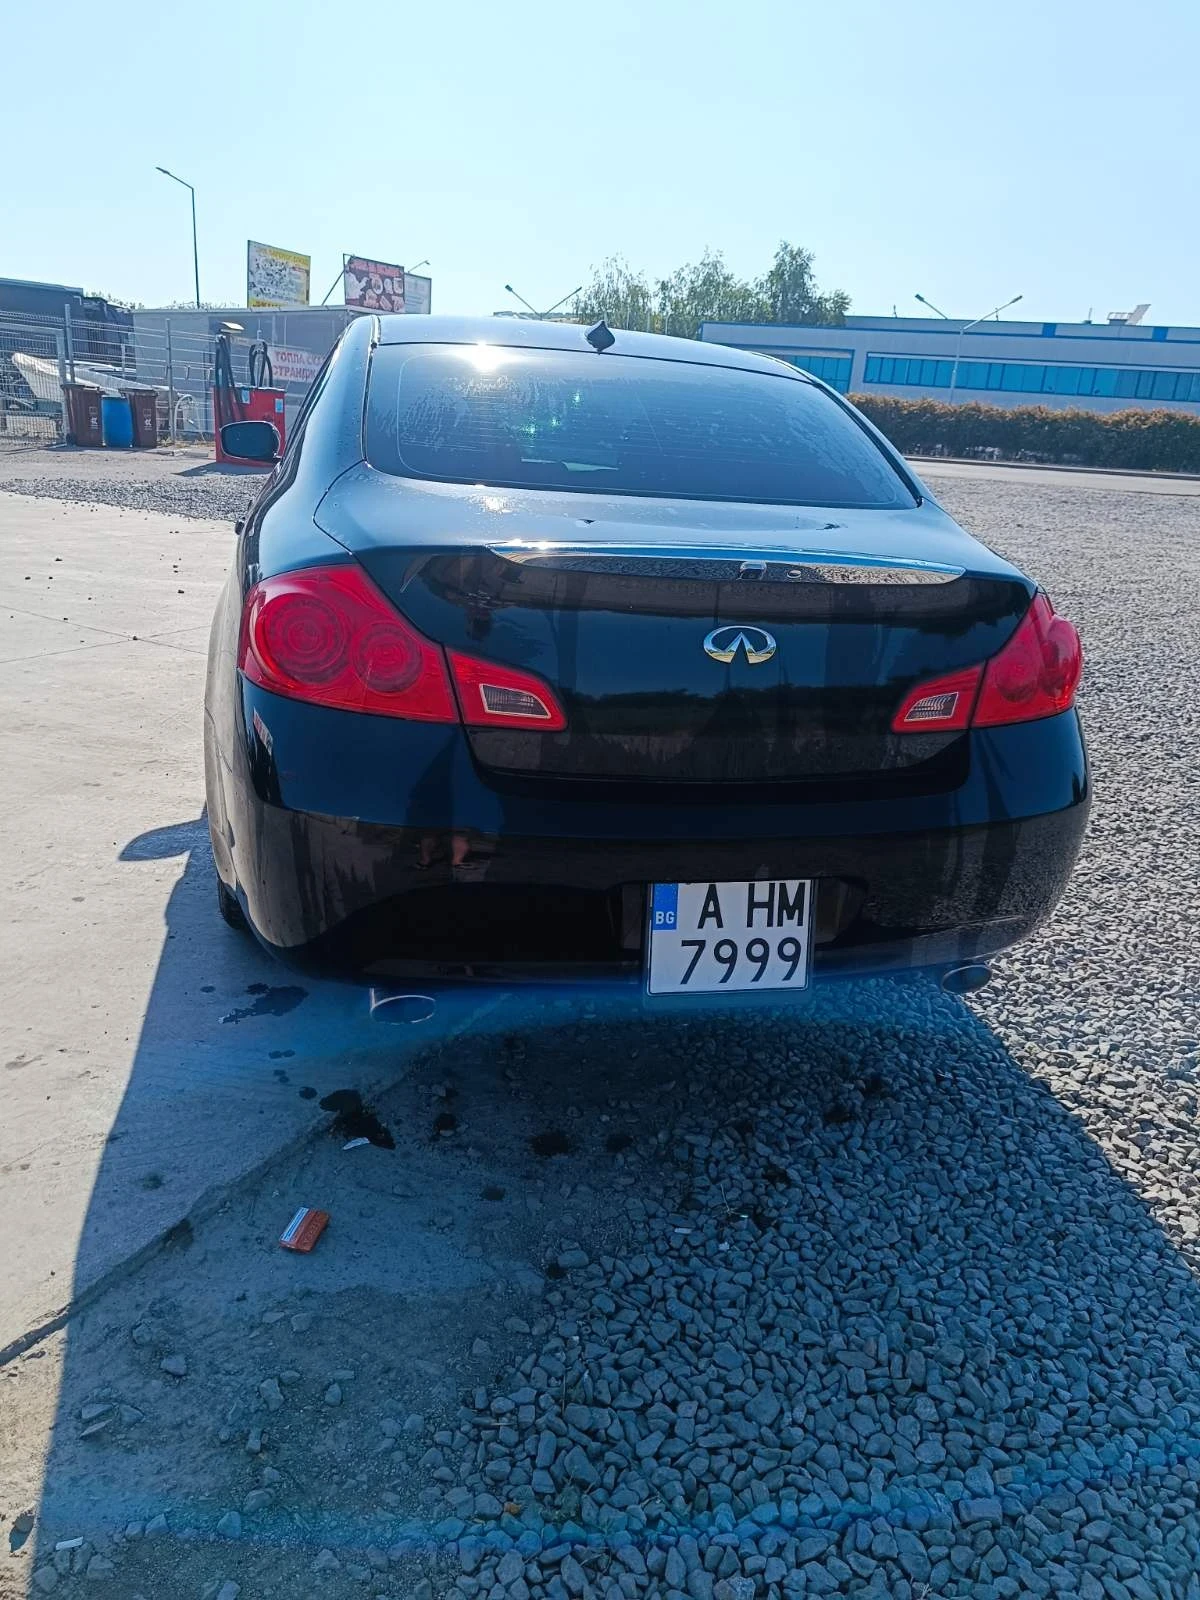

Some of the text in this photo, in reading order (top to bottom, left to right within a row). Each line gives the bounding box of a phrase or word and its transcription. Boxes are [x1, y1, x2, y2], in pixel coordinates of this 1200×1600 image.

[655, 911, 675, 925] BG
[697, 882, 806, 929] A HM
[680, 937, 802, 985] 7999
